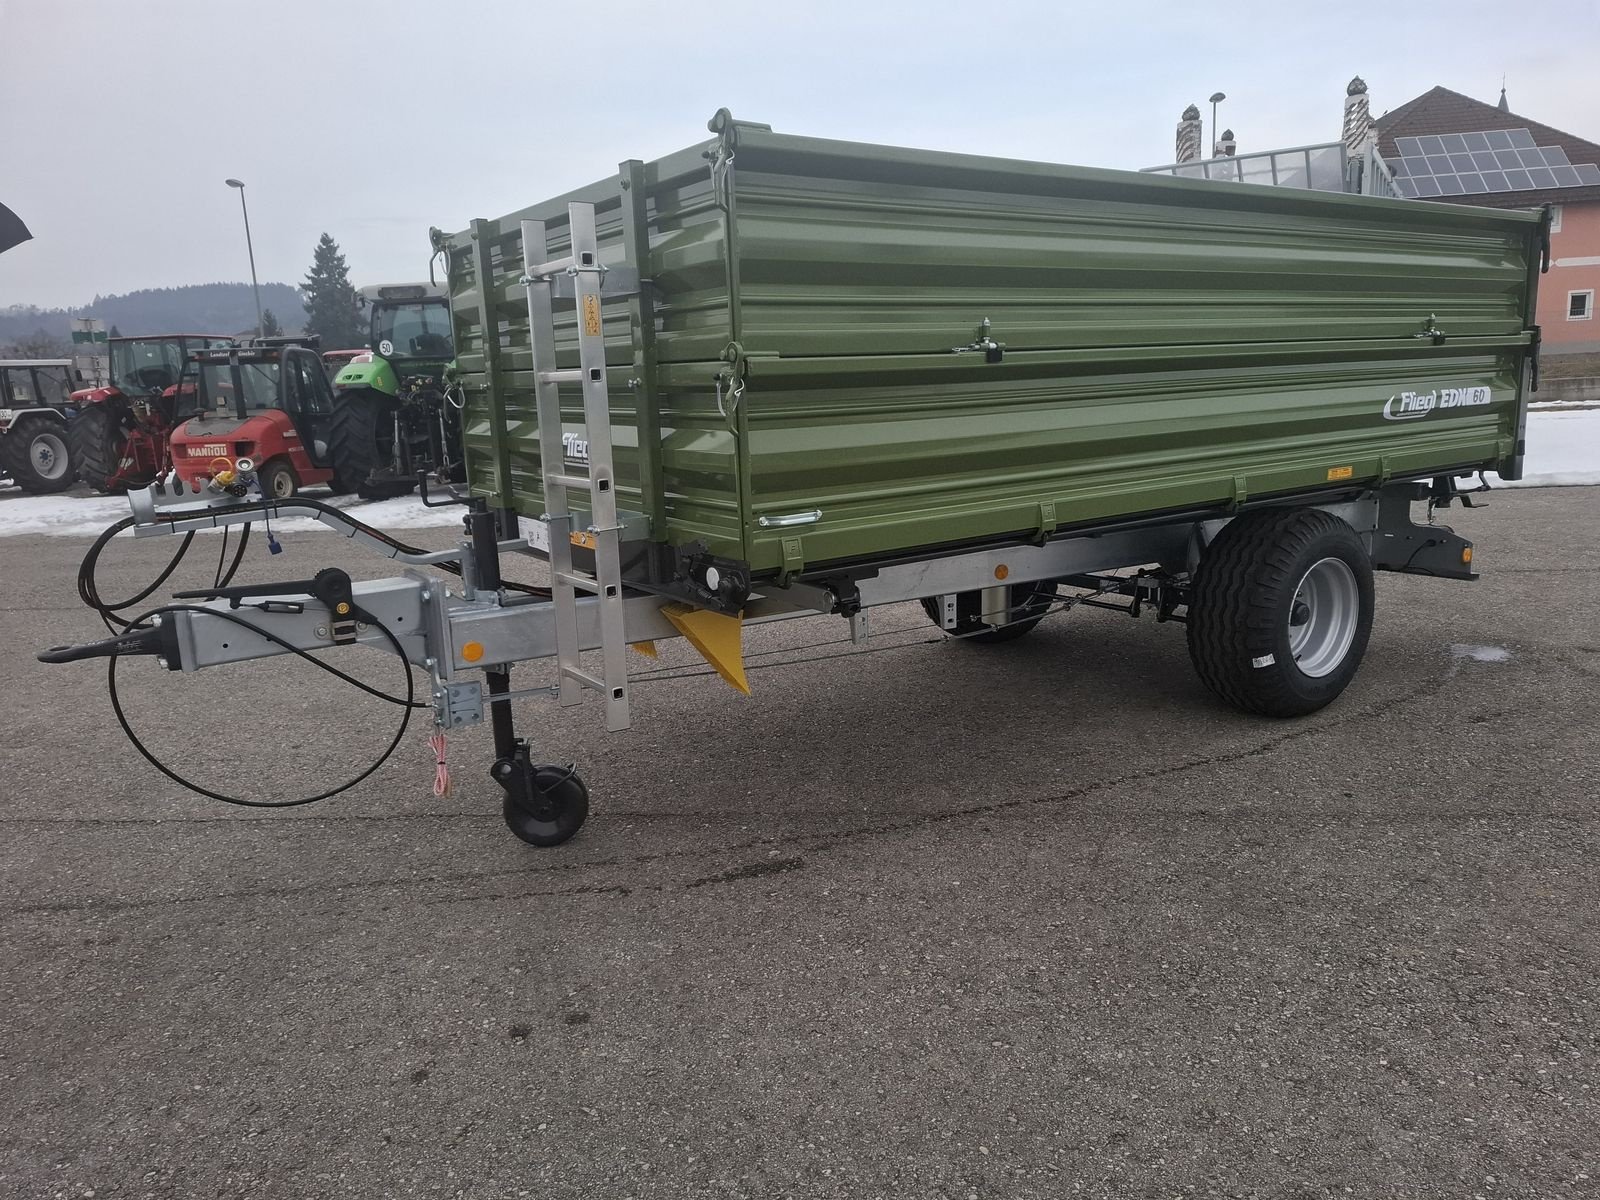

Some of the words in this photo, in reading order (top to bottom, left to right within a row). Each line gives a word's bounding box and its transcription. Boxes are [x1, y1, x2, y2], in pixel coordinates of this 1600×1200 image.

[1400, 390, 1437, 412] Fliegl
[1473, 389, 1485, 403] 60
[187, 443, 228, 457] MANITOU
